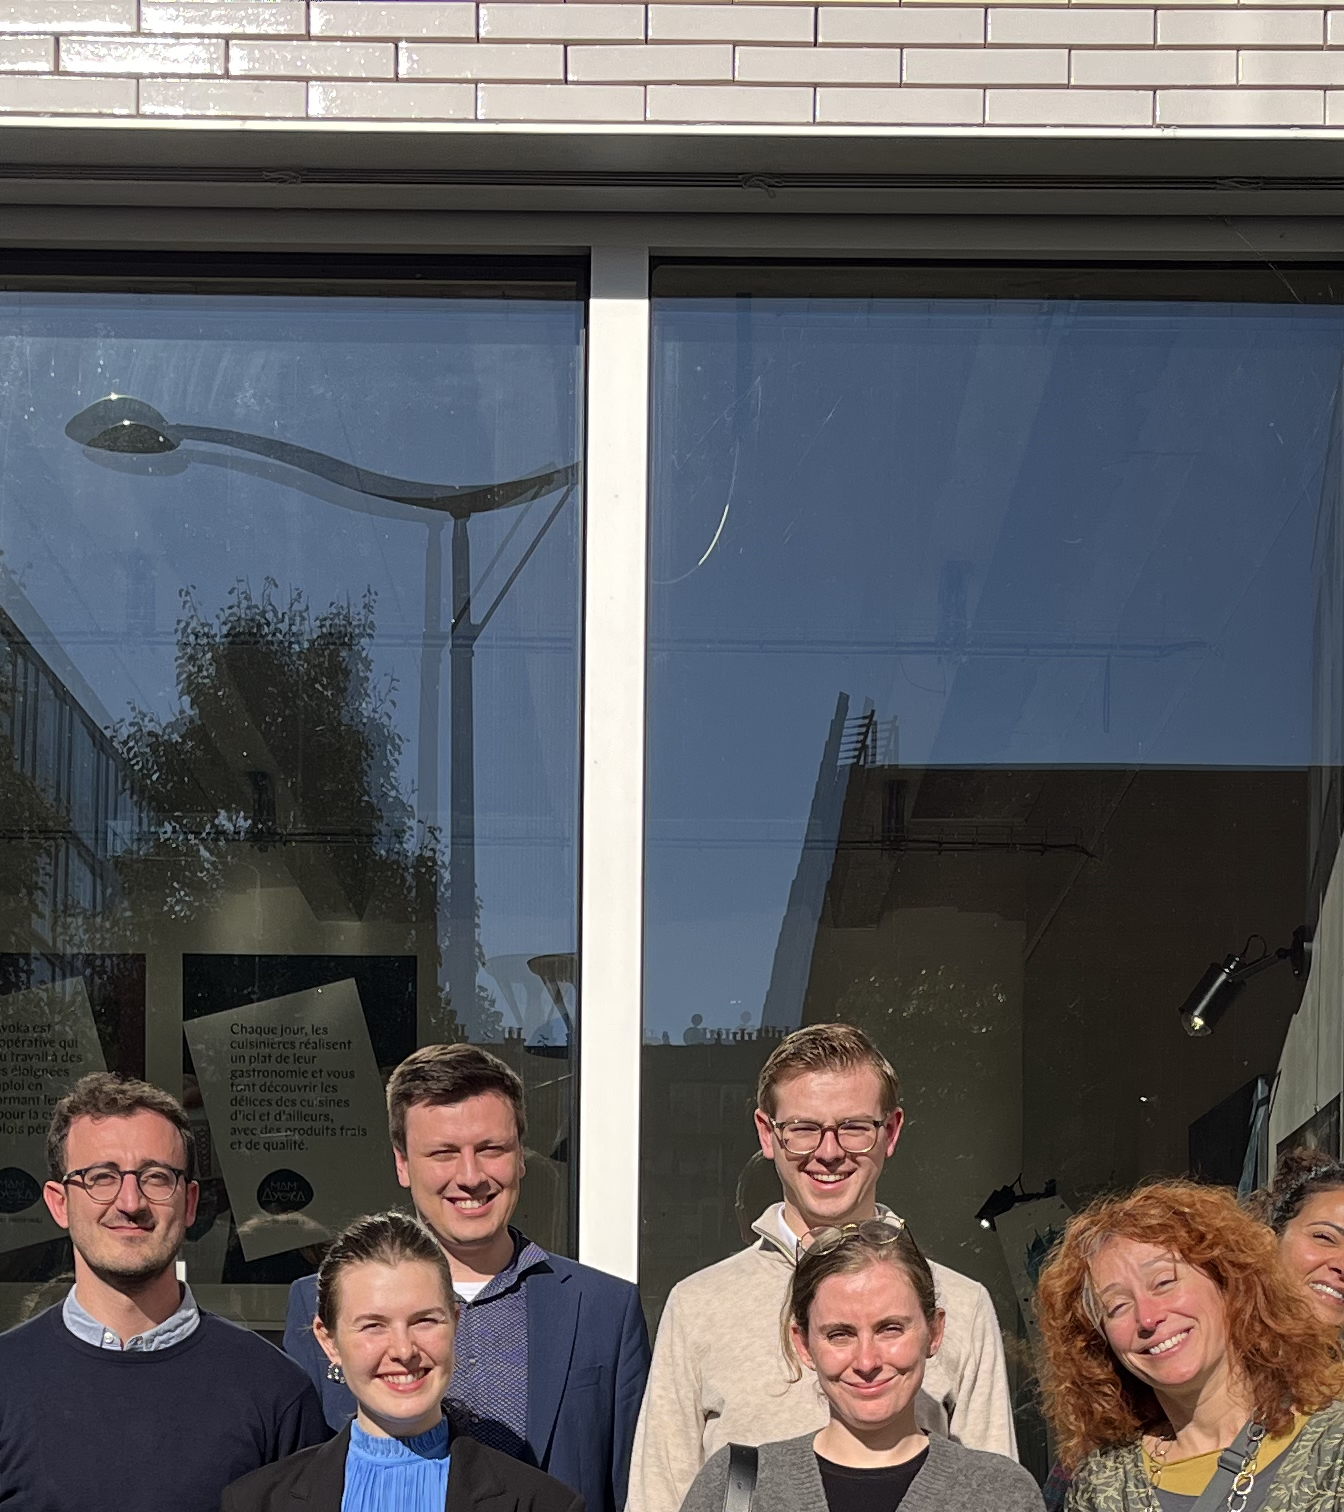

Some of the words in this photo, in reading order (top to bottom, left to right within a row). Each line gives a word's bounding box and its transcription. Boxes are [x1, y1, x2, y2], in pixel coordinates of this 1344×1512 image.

[32, 1023, 52, 1034] est
[230, 1023, 277, 1037] Chaque
[279, 1024, 308, 1037] jour,
[311, 1024, 329, 1035] les
[59, 1037, 79, 1050] qui
[230, 1038, 296, 1050] cuisinières
[299, 1038, 352, 1050] réalisent
[11, 1052, 48, 1063] travail
[61, 1052, 83, 1063] des
[230, 1055, 246, 1064] un
[249, 1053, 273, 1066] plat
[275, 1053, 290, 1064] de
[293, 1053, 317, 1064] leur
[229, 1068, 308, 1082] gastronomie
[311, 1069, 324, 1079] et
[326, 1069, 355, 1079] vous
[28, 1081, 43, 1091] en
[230, 1082, 257, 1093] font
[259, 1082, 317, 1093] découvrir
[321, 1082, 338, 1093] les
[230, 1096, 272, 1108] délices
[275, 1097, 297, 1108] des
[300, 1097, 350, 1108] cuisines
[28, 1109, 39, 1120] la
[230, 1110, 256, 1121] d'ici
[259, 1111, 272, 1121] et
[274, 1110, 334, 1123] d'ailleurs,
[230, 1127, 258, 1137] avec
[260, 1125, 282, 1136] des
[285, 1125, 337, 1139] produits
[340, 1125, 367, 1137] frais
[230, 1141, 242, 1151] et
[245, 1140, 260, 1151] de
[263, 1140, 309, 1152] qualité.
